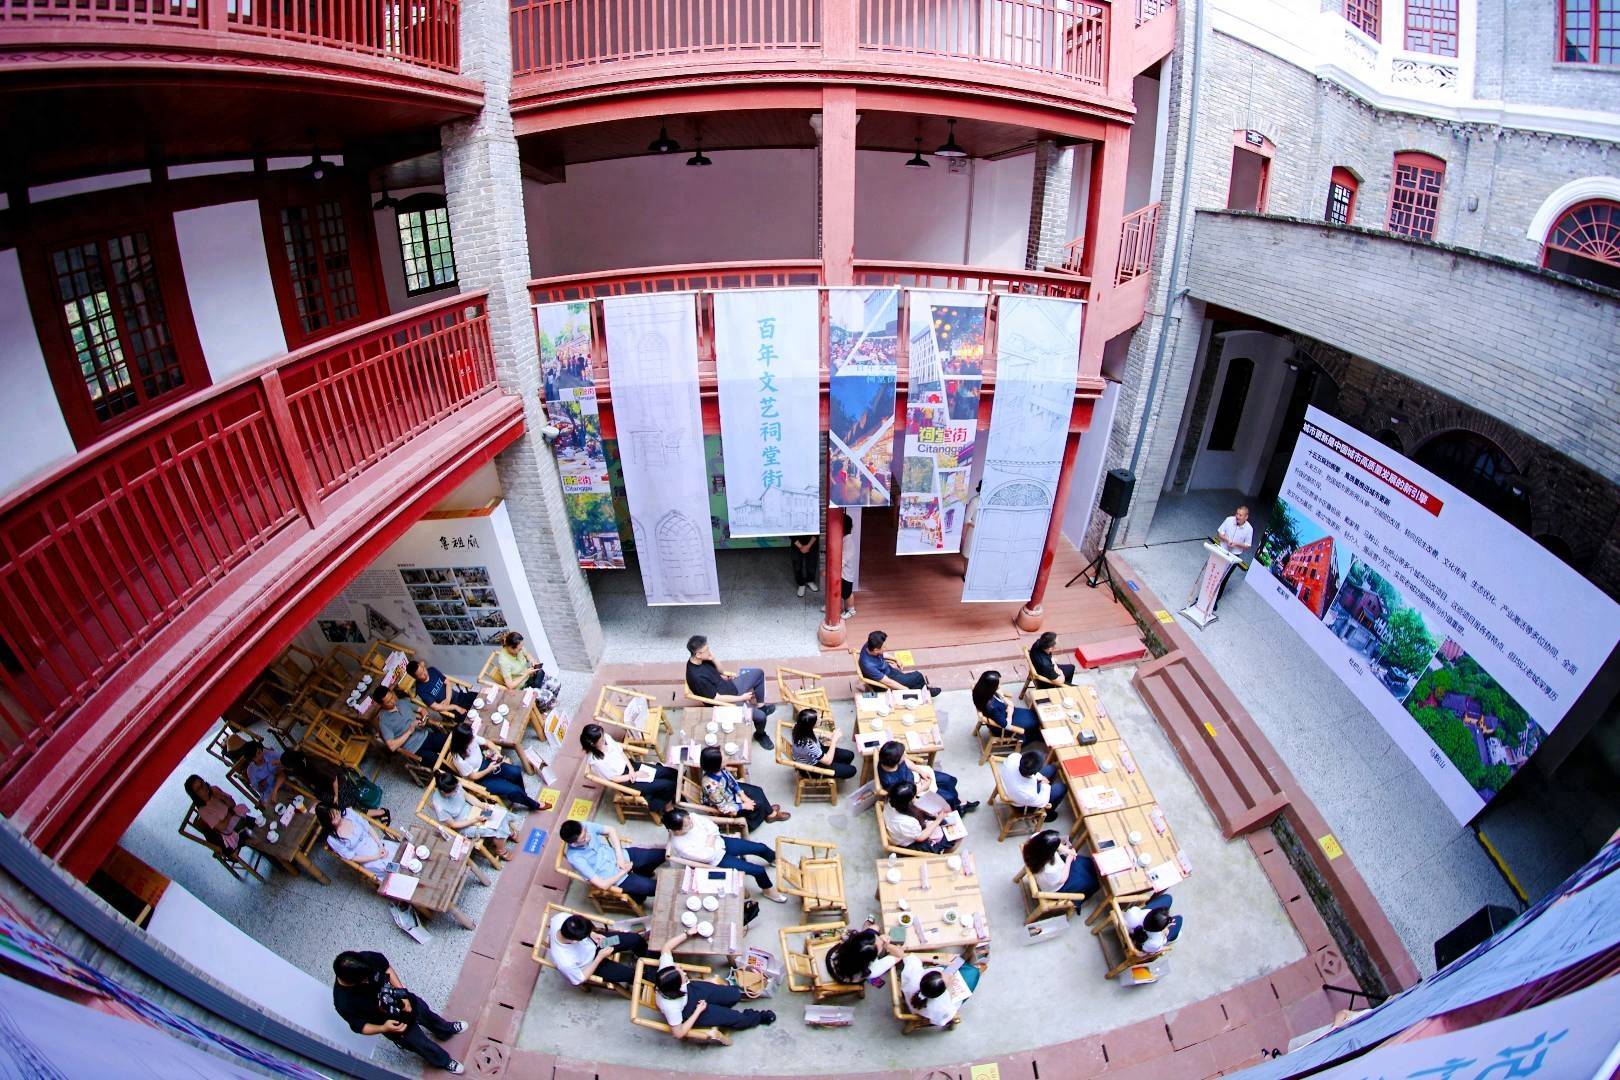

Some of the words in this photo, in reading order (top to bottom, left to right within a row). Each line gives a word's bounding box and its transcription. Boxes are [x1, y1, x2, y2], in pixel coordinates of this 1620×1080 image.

[757, 317, 783, 488] 百年文艺祠堂街
[1303, 422, 1429, 504] 城市更新是中国城市高质量发展的新引擎
